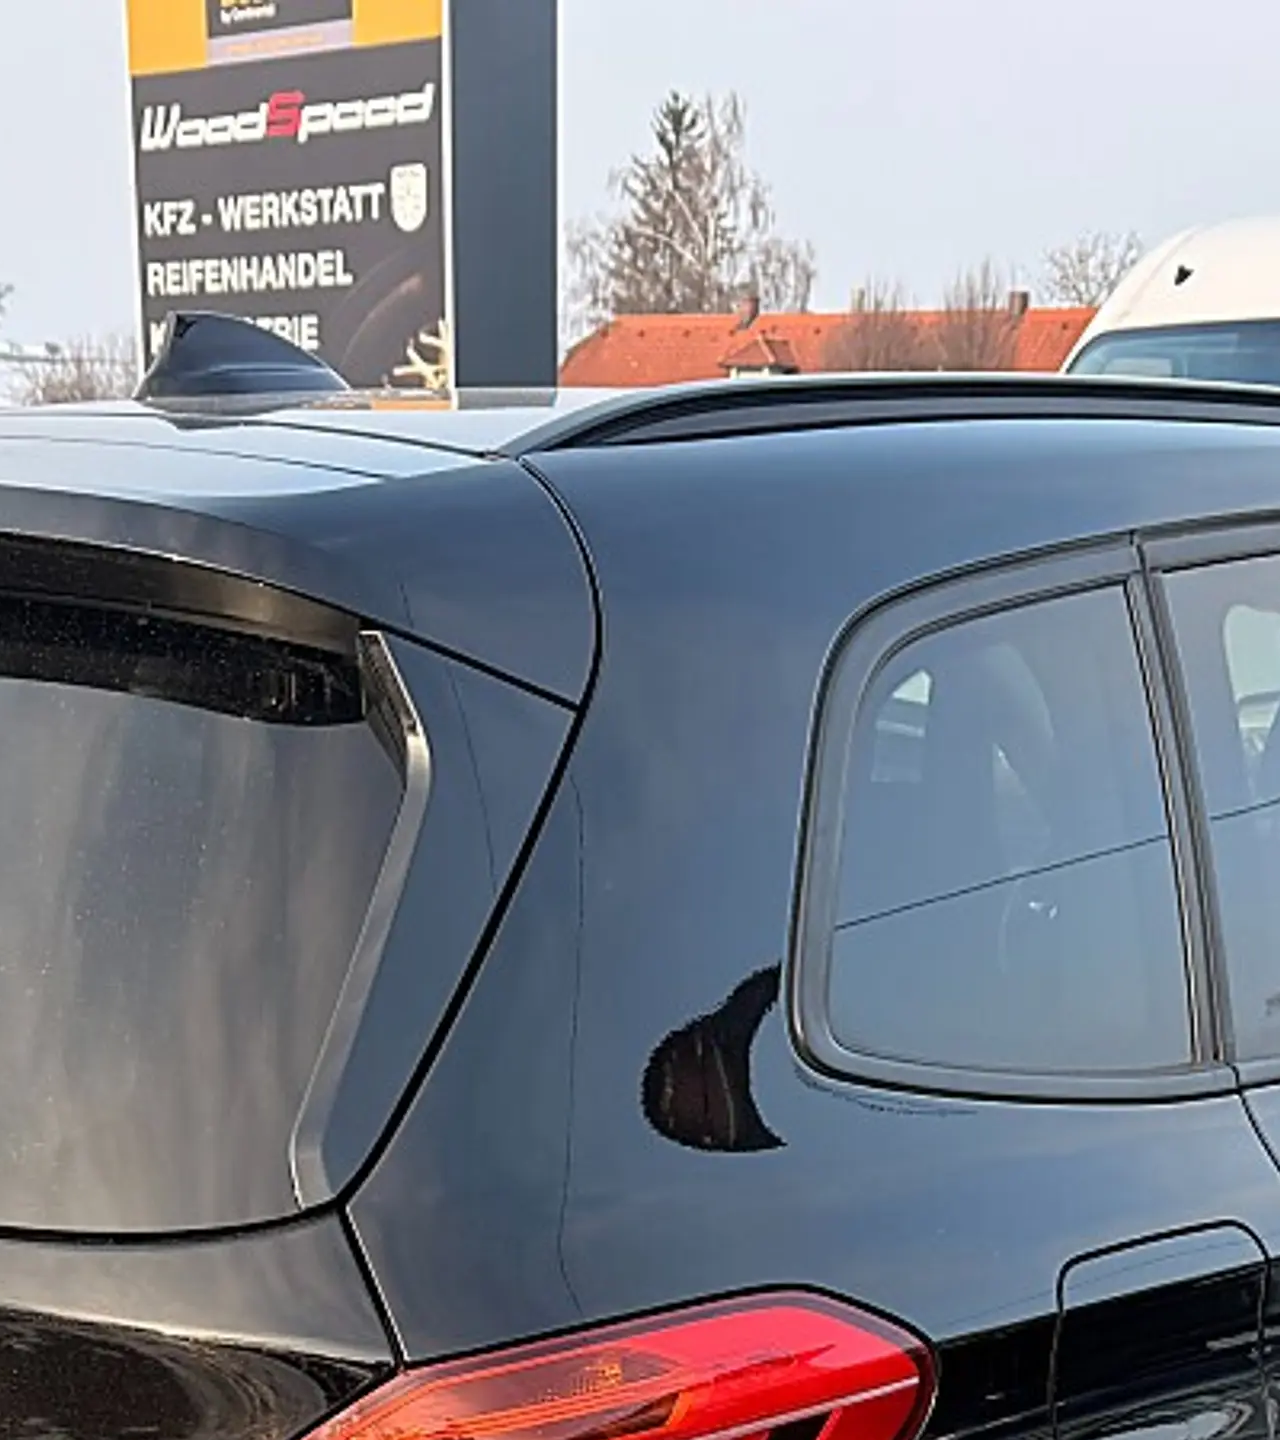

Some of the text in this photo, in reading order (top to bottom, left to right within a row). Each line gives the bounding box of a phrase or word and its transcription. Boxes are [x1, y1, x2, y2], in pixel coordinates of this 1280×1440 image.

[143, 200, 197, 238] KFZ
[217, 182, 385, 232] WERKSTATT
[147, 250, 354, 296] REIFENHANDEL
